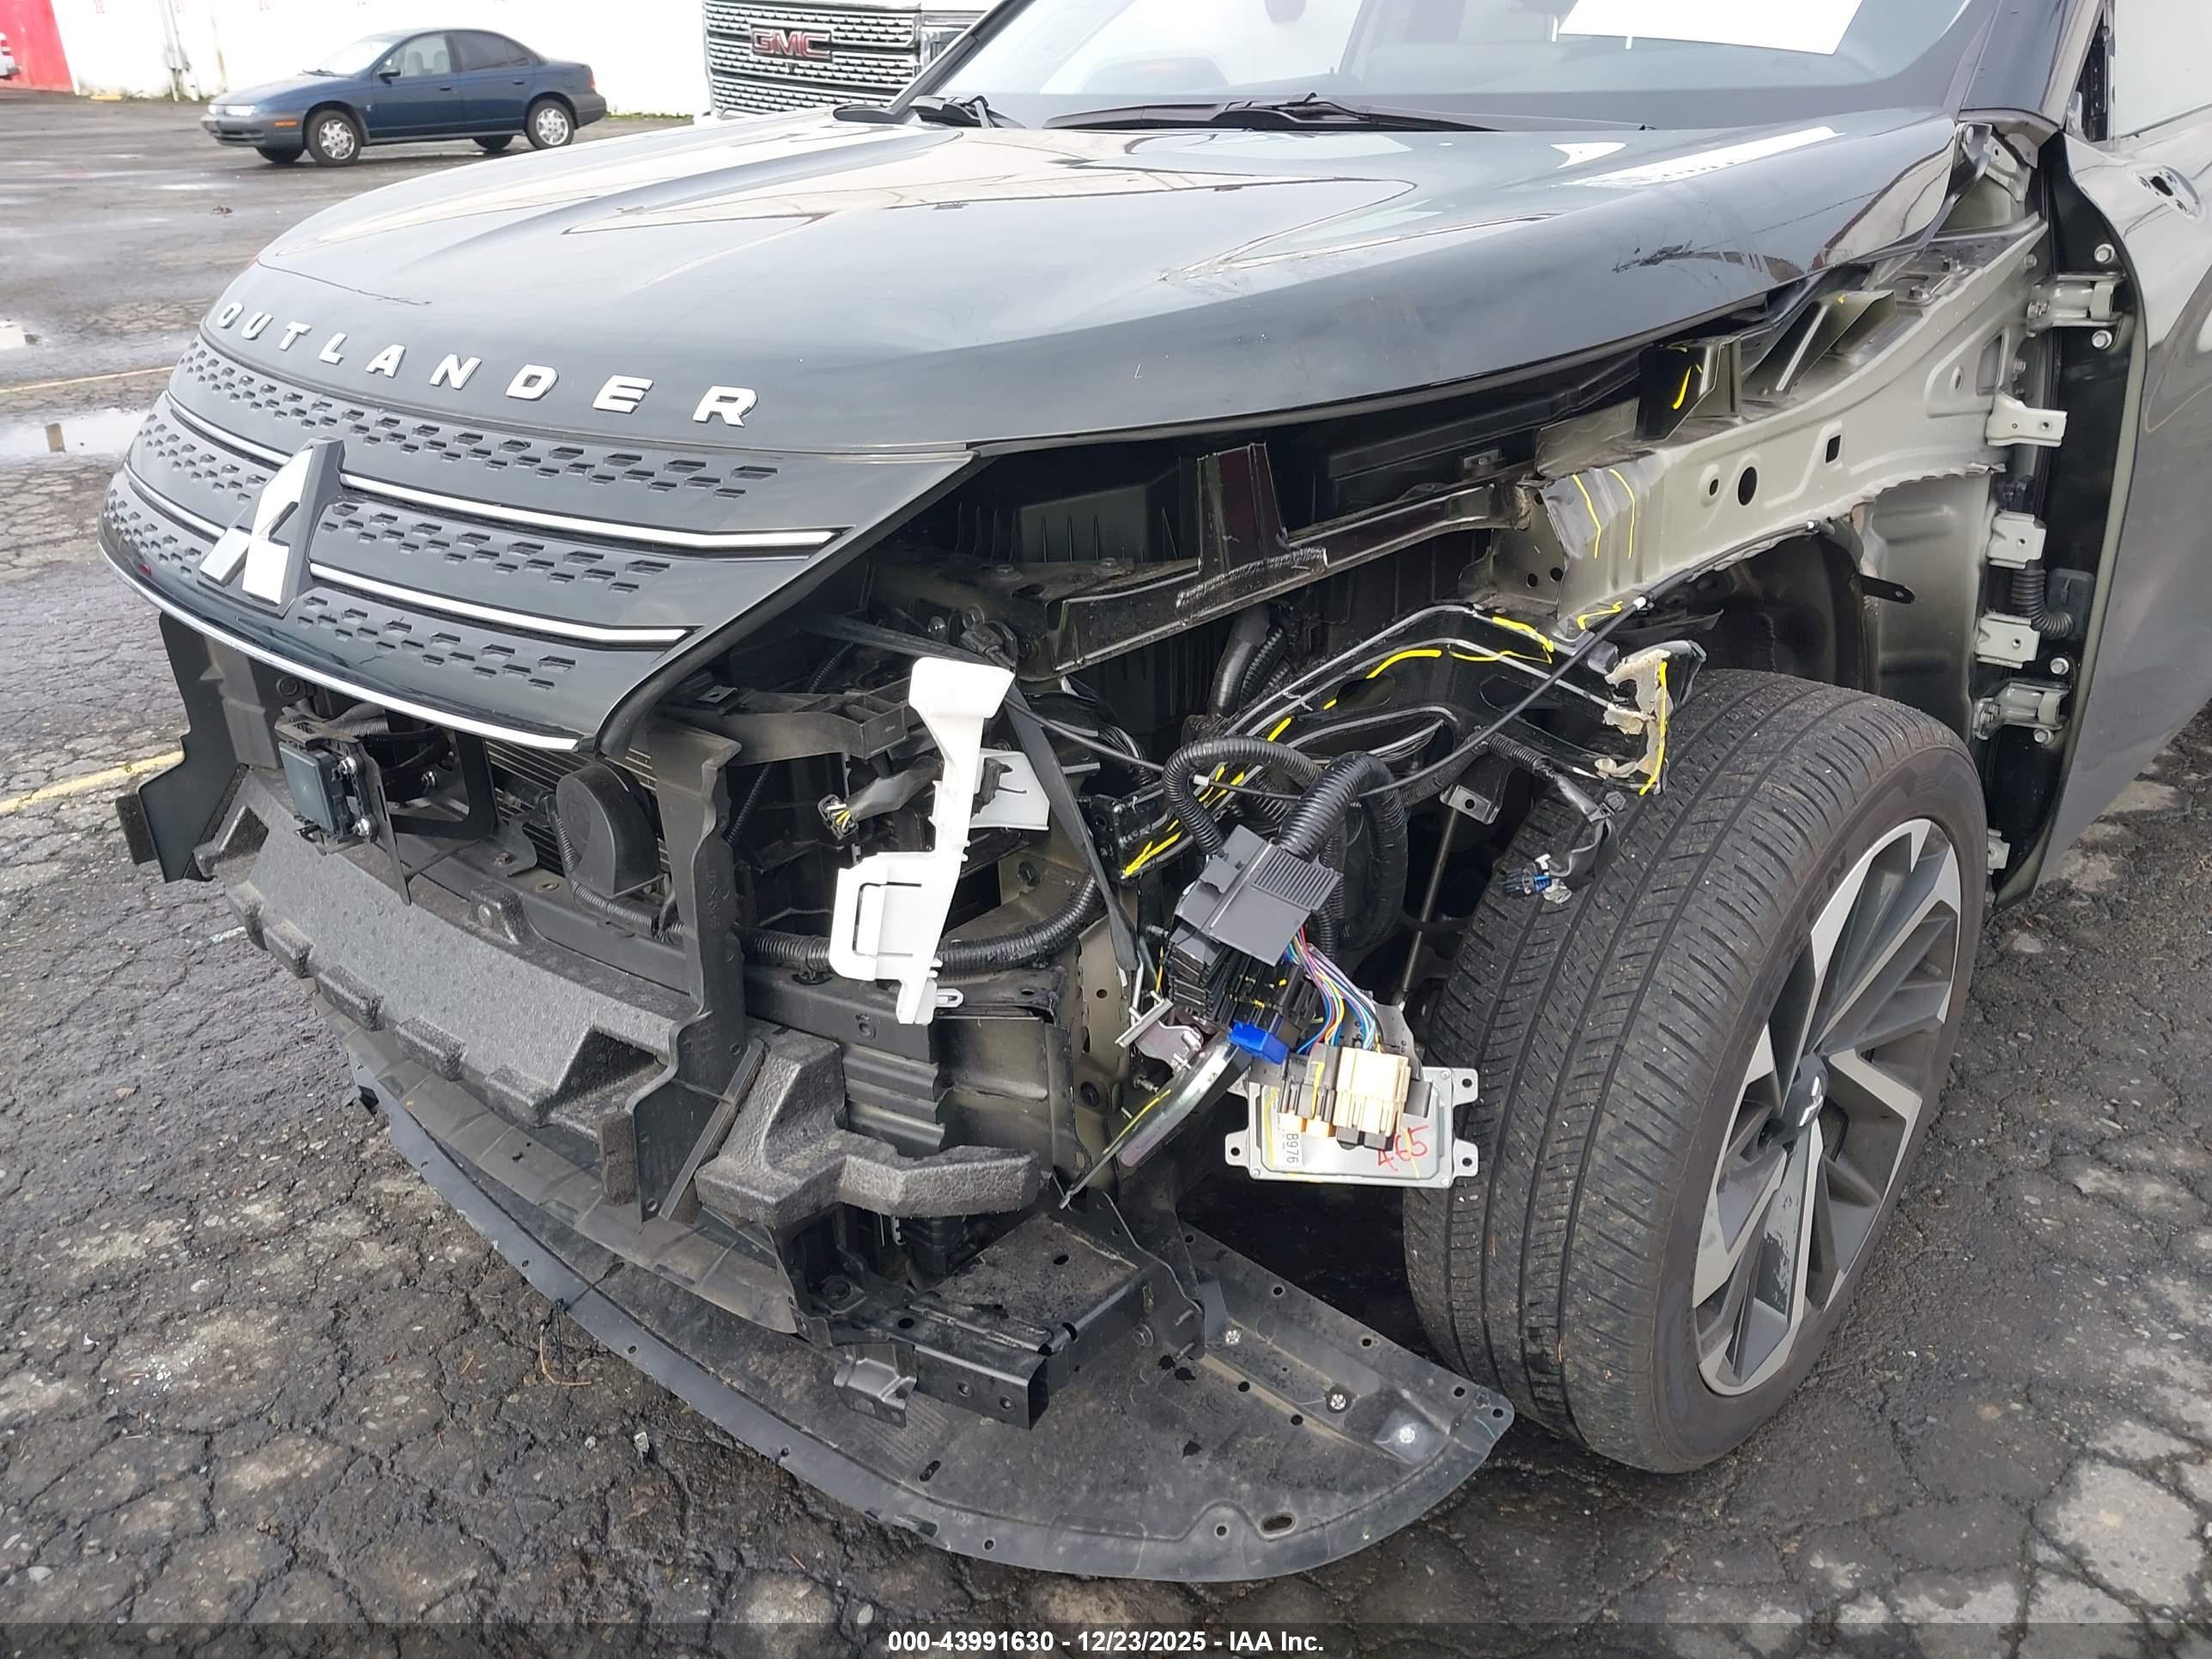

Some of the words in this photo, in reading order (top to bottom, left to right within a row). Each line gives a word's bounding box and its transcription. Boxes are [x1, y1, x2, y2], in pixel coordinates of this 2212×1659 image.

[751, 27, 831, 58] GMC
[216, 301, 758, 428] OUTLANDER
[1285, 1133, 1299, 1164] B976
